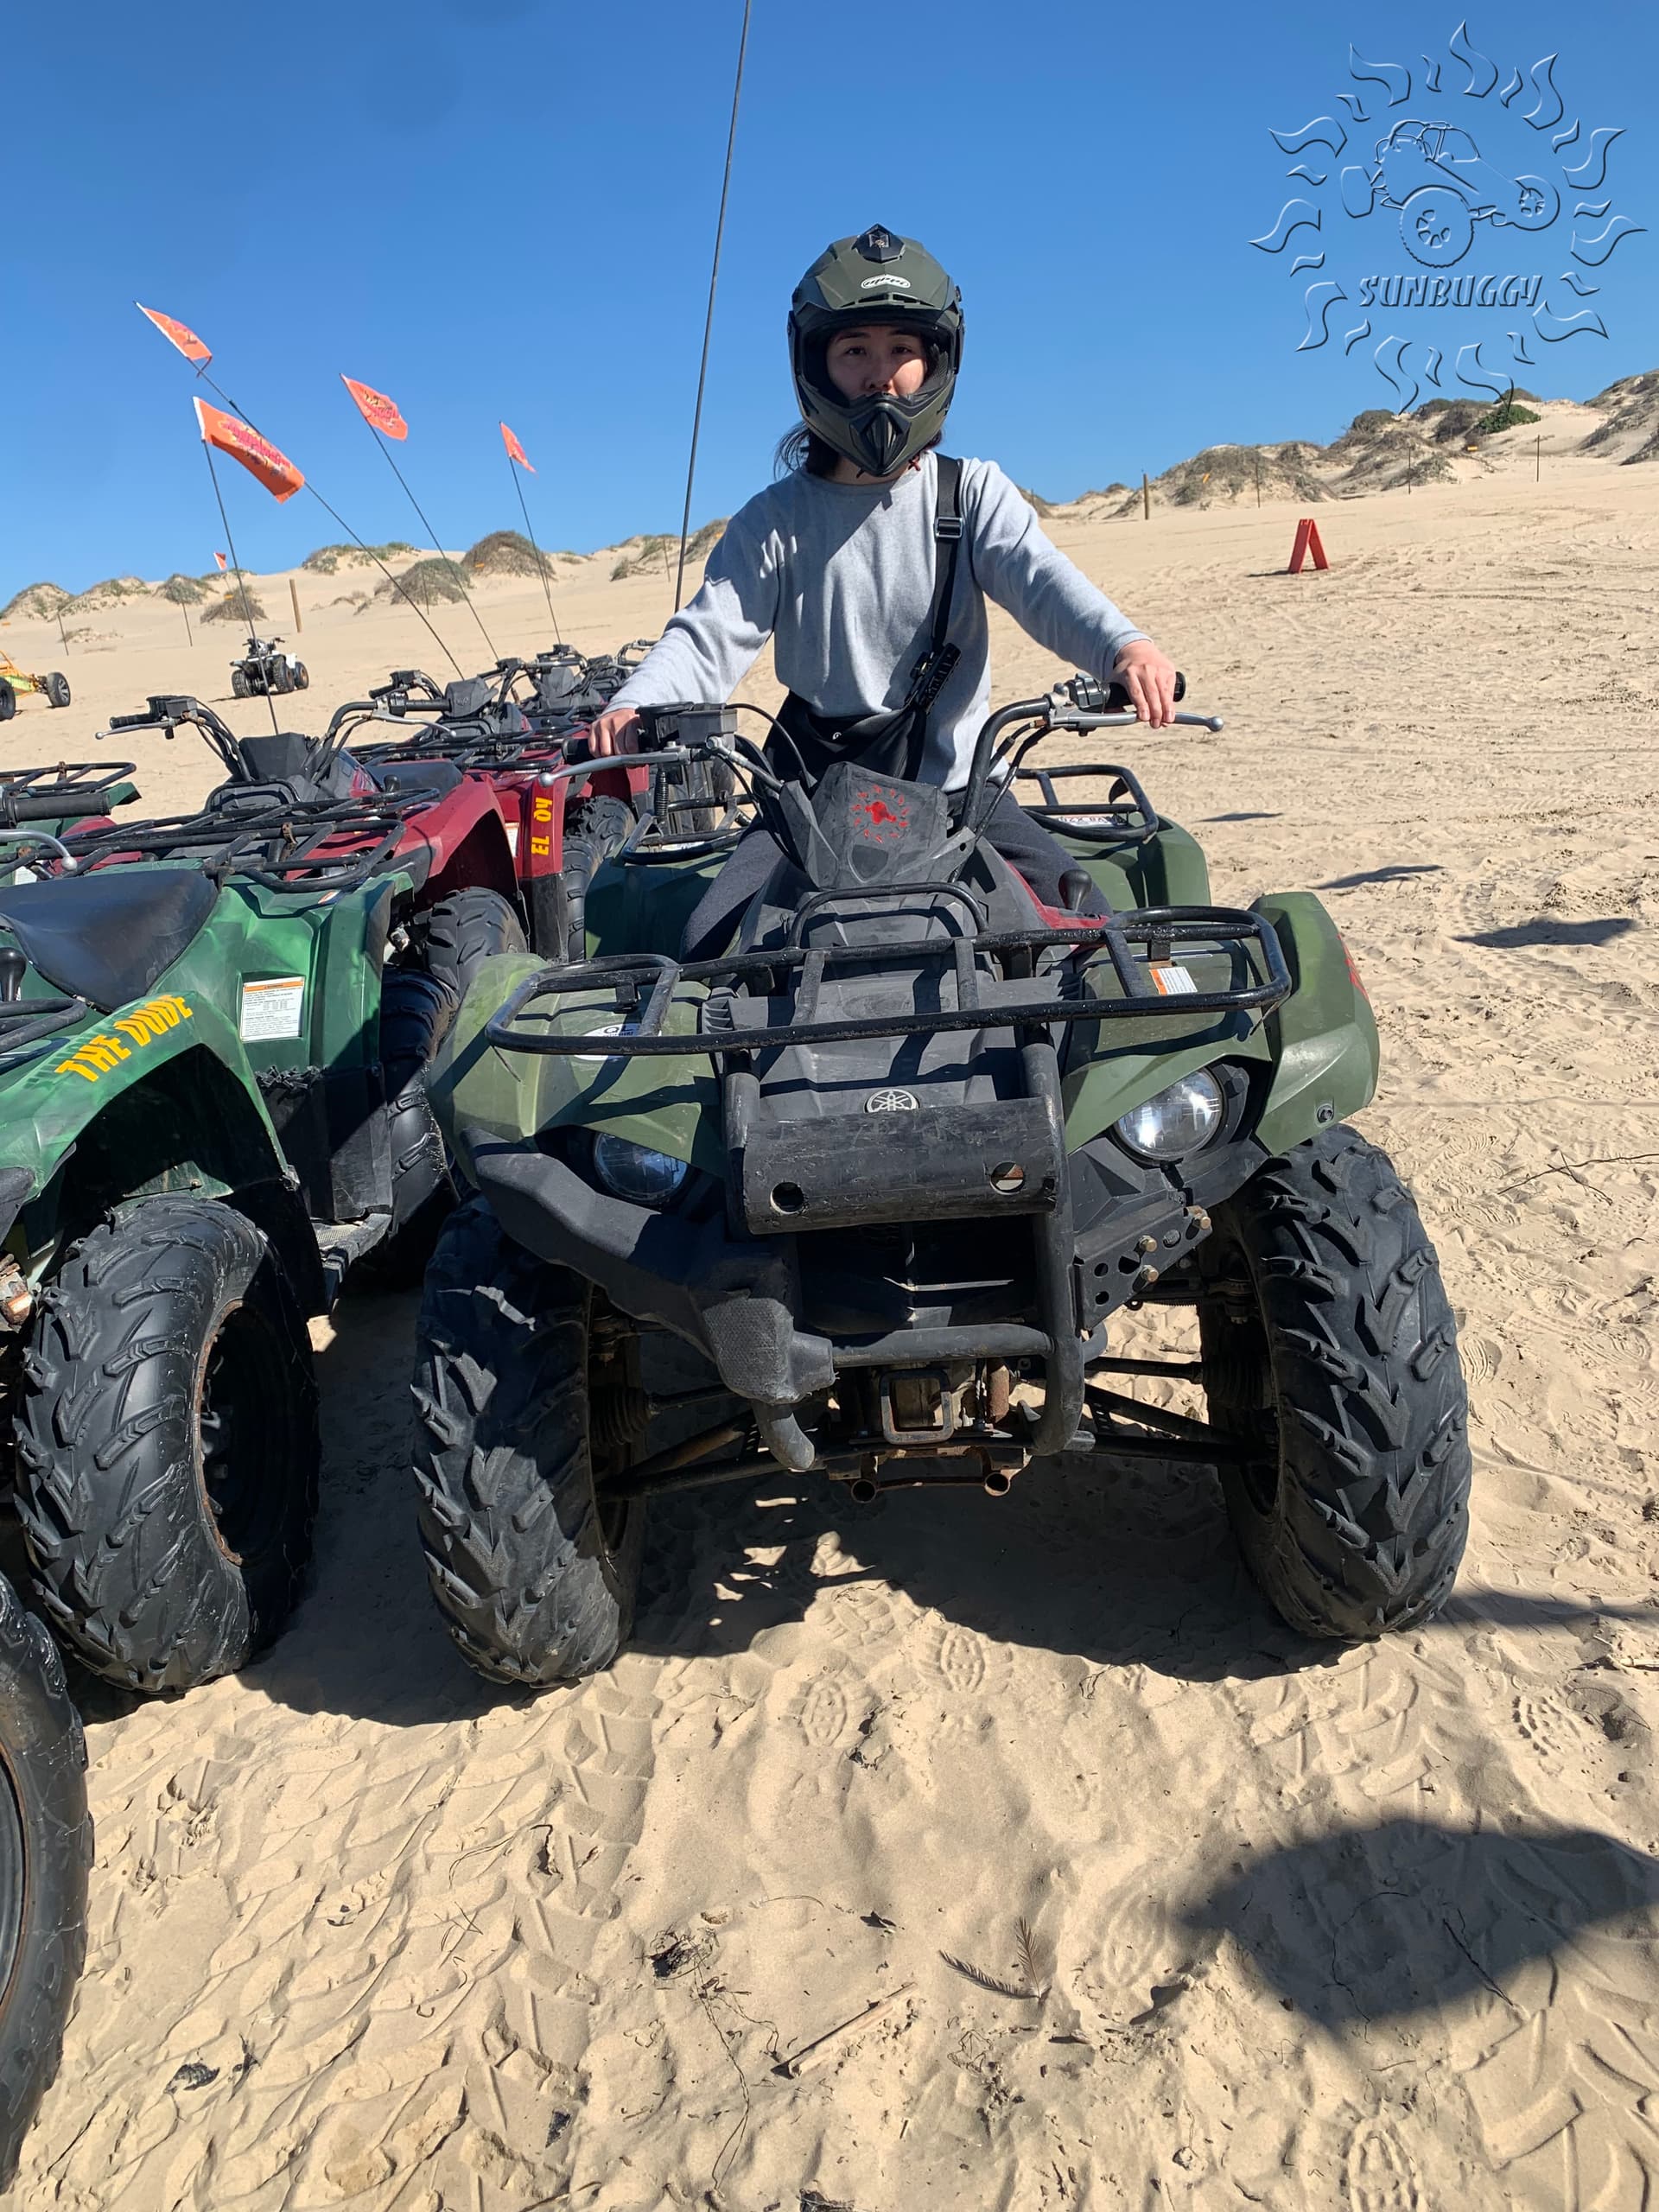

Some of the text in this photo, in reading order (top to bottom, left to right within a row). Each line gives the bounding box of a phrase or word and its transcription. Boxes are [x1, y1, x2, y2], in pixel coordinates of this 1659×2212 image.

[531, 836, 550, 855] EL
[54, 1034, 131, 1082] THE
[113, 995, 194, 1047] DUDE
